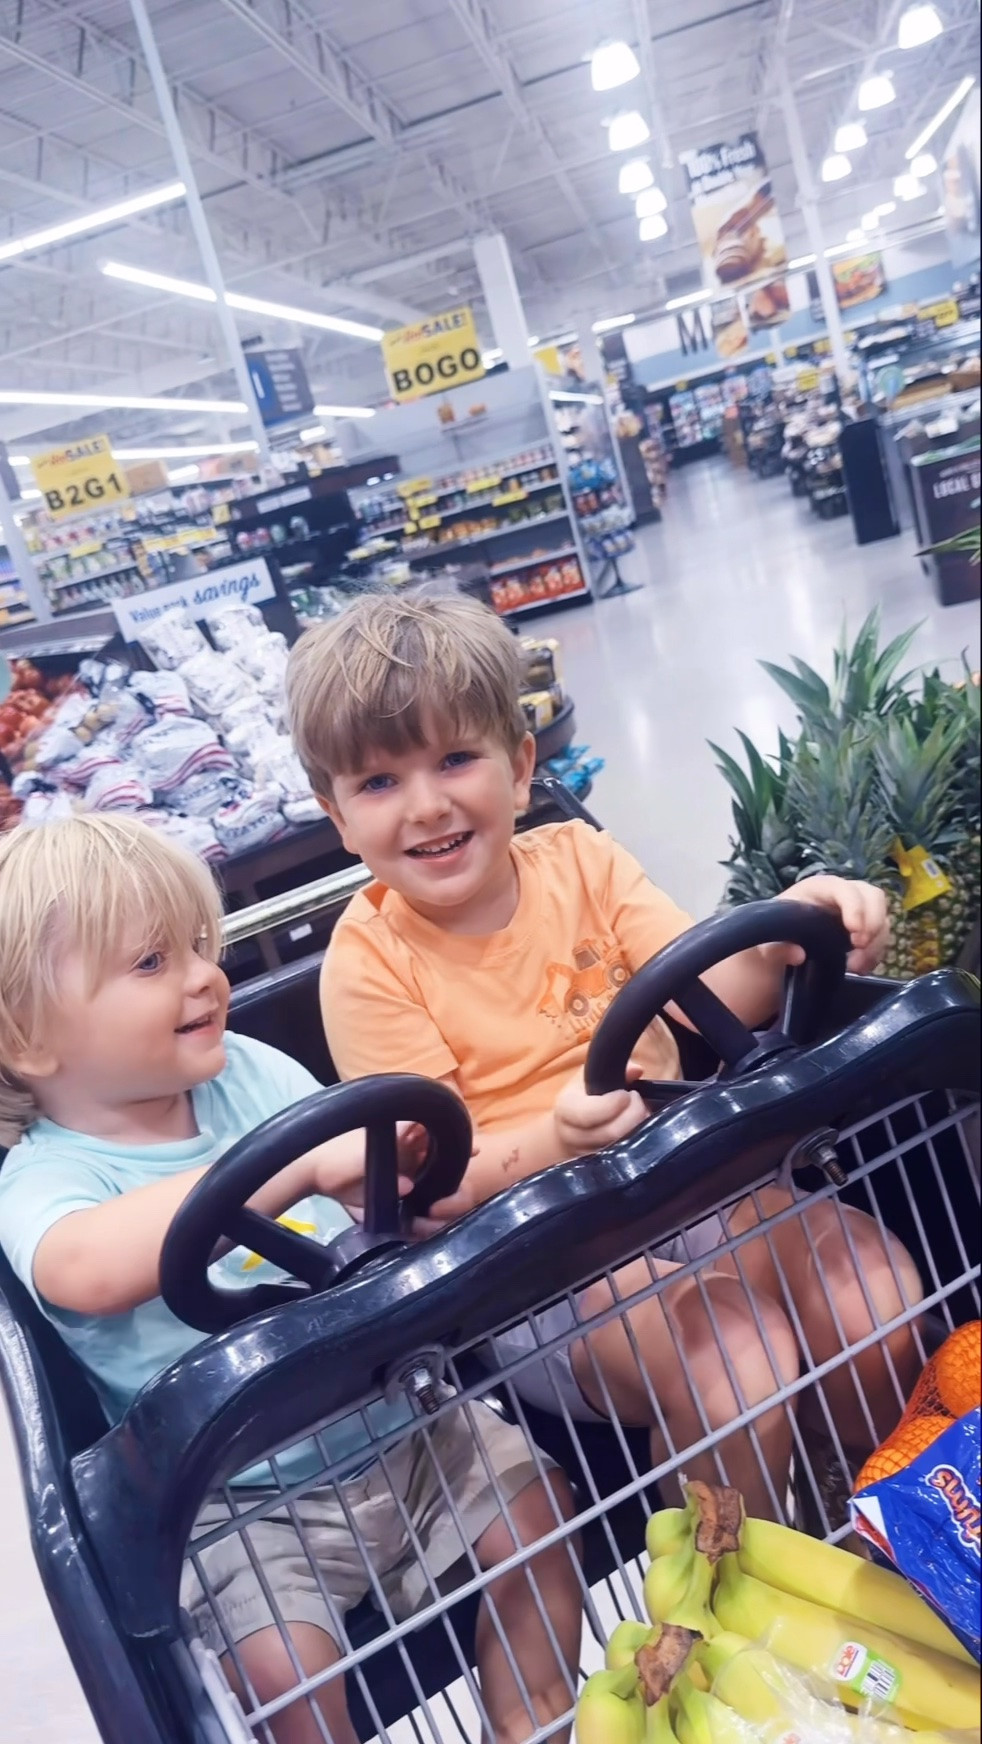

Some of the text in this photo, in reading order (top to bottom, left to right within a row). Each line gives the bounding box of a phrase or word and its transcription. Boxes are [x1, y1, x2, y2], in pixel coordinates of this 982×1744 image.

[392, 347, 479, 392] BOGO
[44, 472, 122, 511] B2G1
[932, 475, 970, 498] LOCAL
[129, 606, 162, 625] Value
[193, 573, 260, 603] savings
